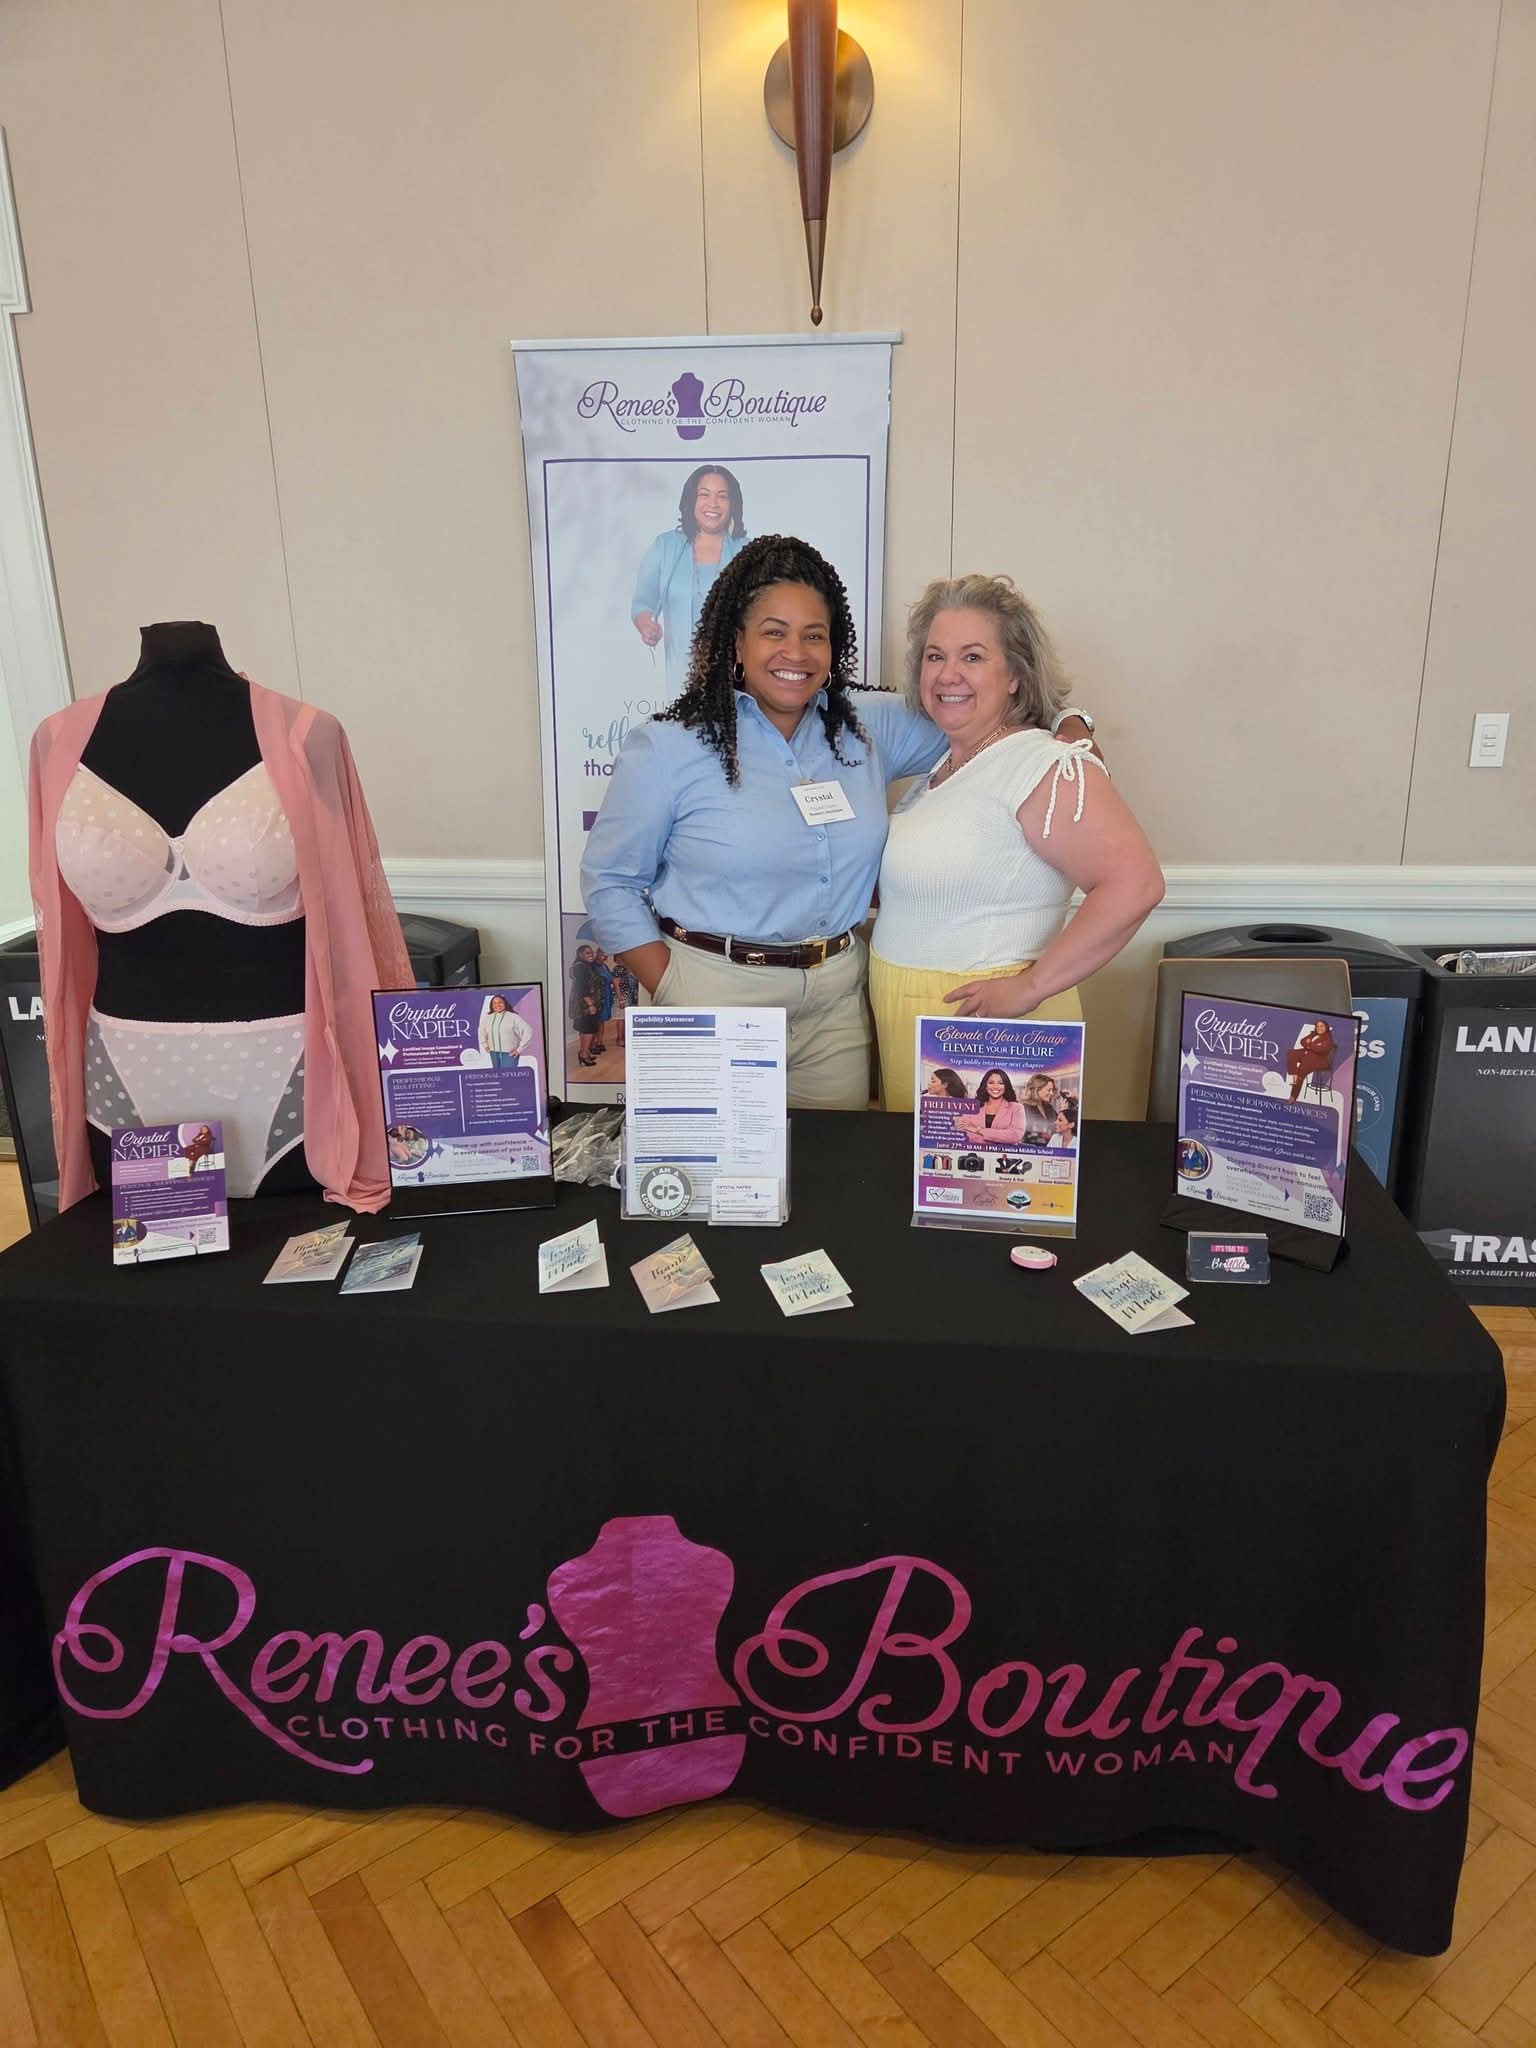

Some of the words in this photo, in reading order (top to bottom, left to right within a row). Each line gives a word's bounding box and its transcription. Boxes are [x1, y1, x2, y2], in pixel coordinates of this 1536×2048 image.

[577, 381, 676, 432] Renee's
[703, 379, 827, 427] Boutique
[705, 417, 755, 425] CONFIDENT
[757, 416, 791, 424] WOMAN
[624, 700, 666, 715] YOU
[582, 716, 629, 757] refl
[804, 791, 833, 803] Crystal
[8, 996, 45, 1021] LA
[389, 1001, 457, 1024] Crystal
[392, 1019, 471, 1041] NAPIER
[633, 1016, 664, 1024] Capability
[1195, 1009, 1267, 1037] Crystal
[935, 1025, 983, 1042] Elevate
[984, 1027, 1022, 1044] Your
[1022, 1029, 1067, 1046] Image
[1455, 1025, 1536, 1053] LAN
[943, 1042, 984, 1054] ELEVATE
[986, 1045, 1008, 1054] YOUR
[1010, 1045, 1055, 1057] FUTURE
[1195, 1031, 1279, 1063] NAPIER
[950, 1058, 963, 1066] Step
[964, 1058, 982, 1067] boldly
[1022, 1062, 1045, 1070] chapter
[924, 1100, 944, 1109] FREE
[947, 1102, 976, 1111] EVENT
[1191, 1087, 1234, 1102] PERSONAL
[1237, 1096, 1281, 1111] SHOPPING
[1283, 1104, 1328, 1120] SERVICES
[119, 1130, 172, 1148] Crystal
[113, 1143, 181, 1161] NAPIER
[641, 1193, 659, 1216] LOCAL
[660, 1194, 690, 1218] BUSINESS
[53, 1546, 575, 1775] Renee's
[733, 1555, 1469, 1811] Boutique
[286, 1716, 509, 1749] CLOTHING
[529, 1726, 616, 1761] FOR
[640, 1710, 728, 1746] THE
[749, 1715, 1024, 1776] CONFIDENT
[1045, 1738, 1235, 1776] WOMAN
